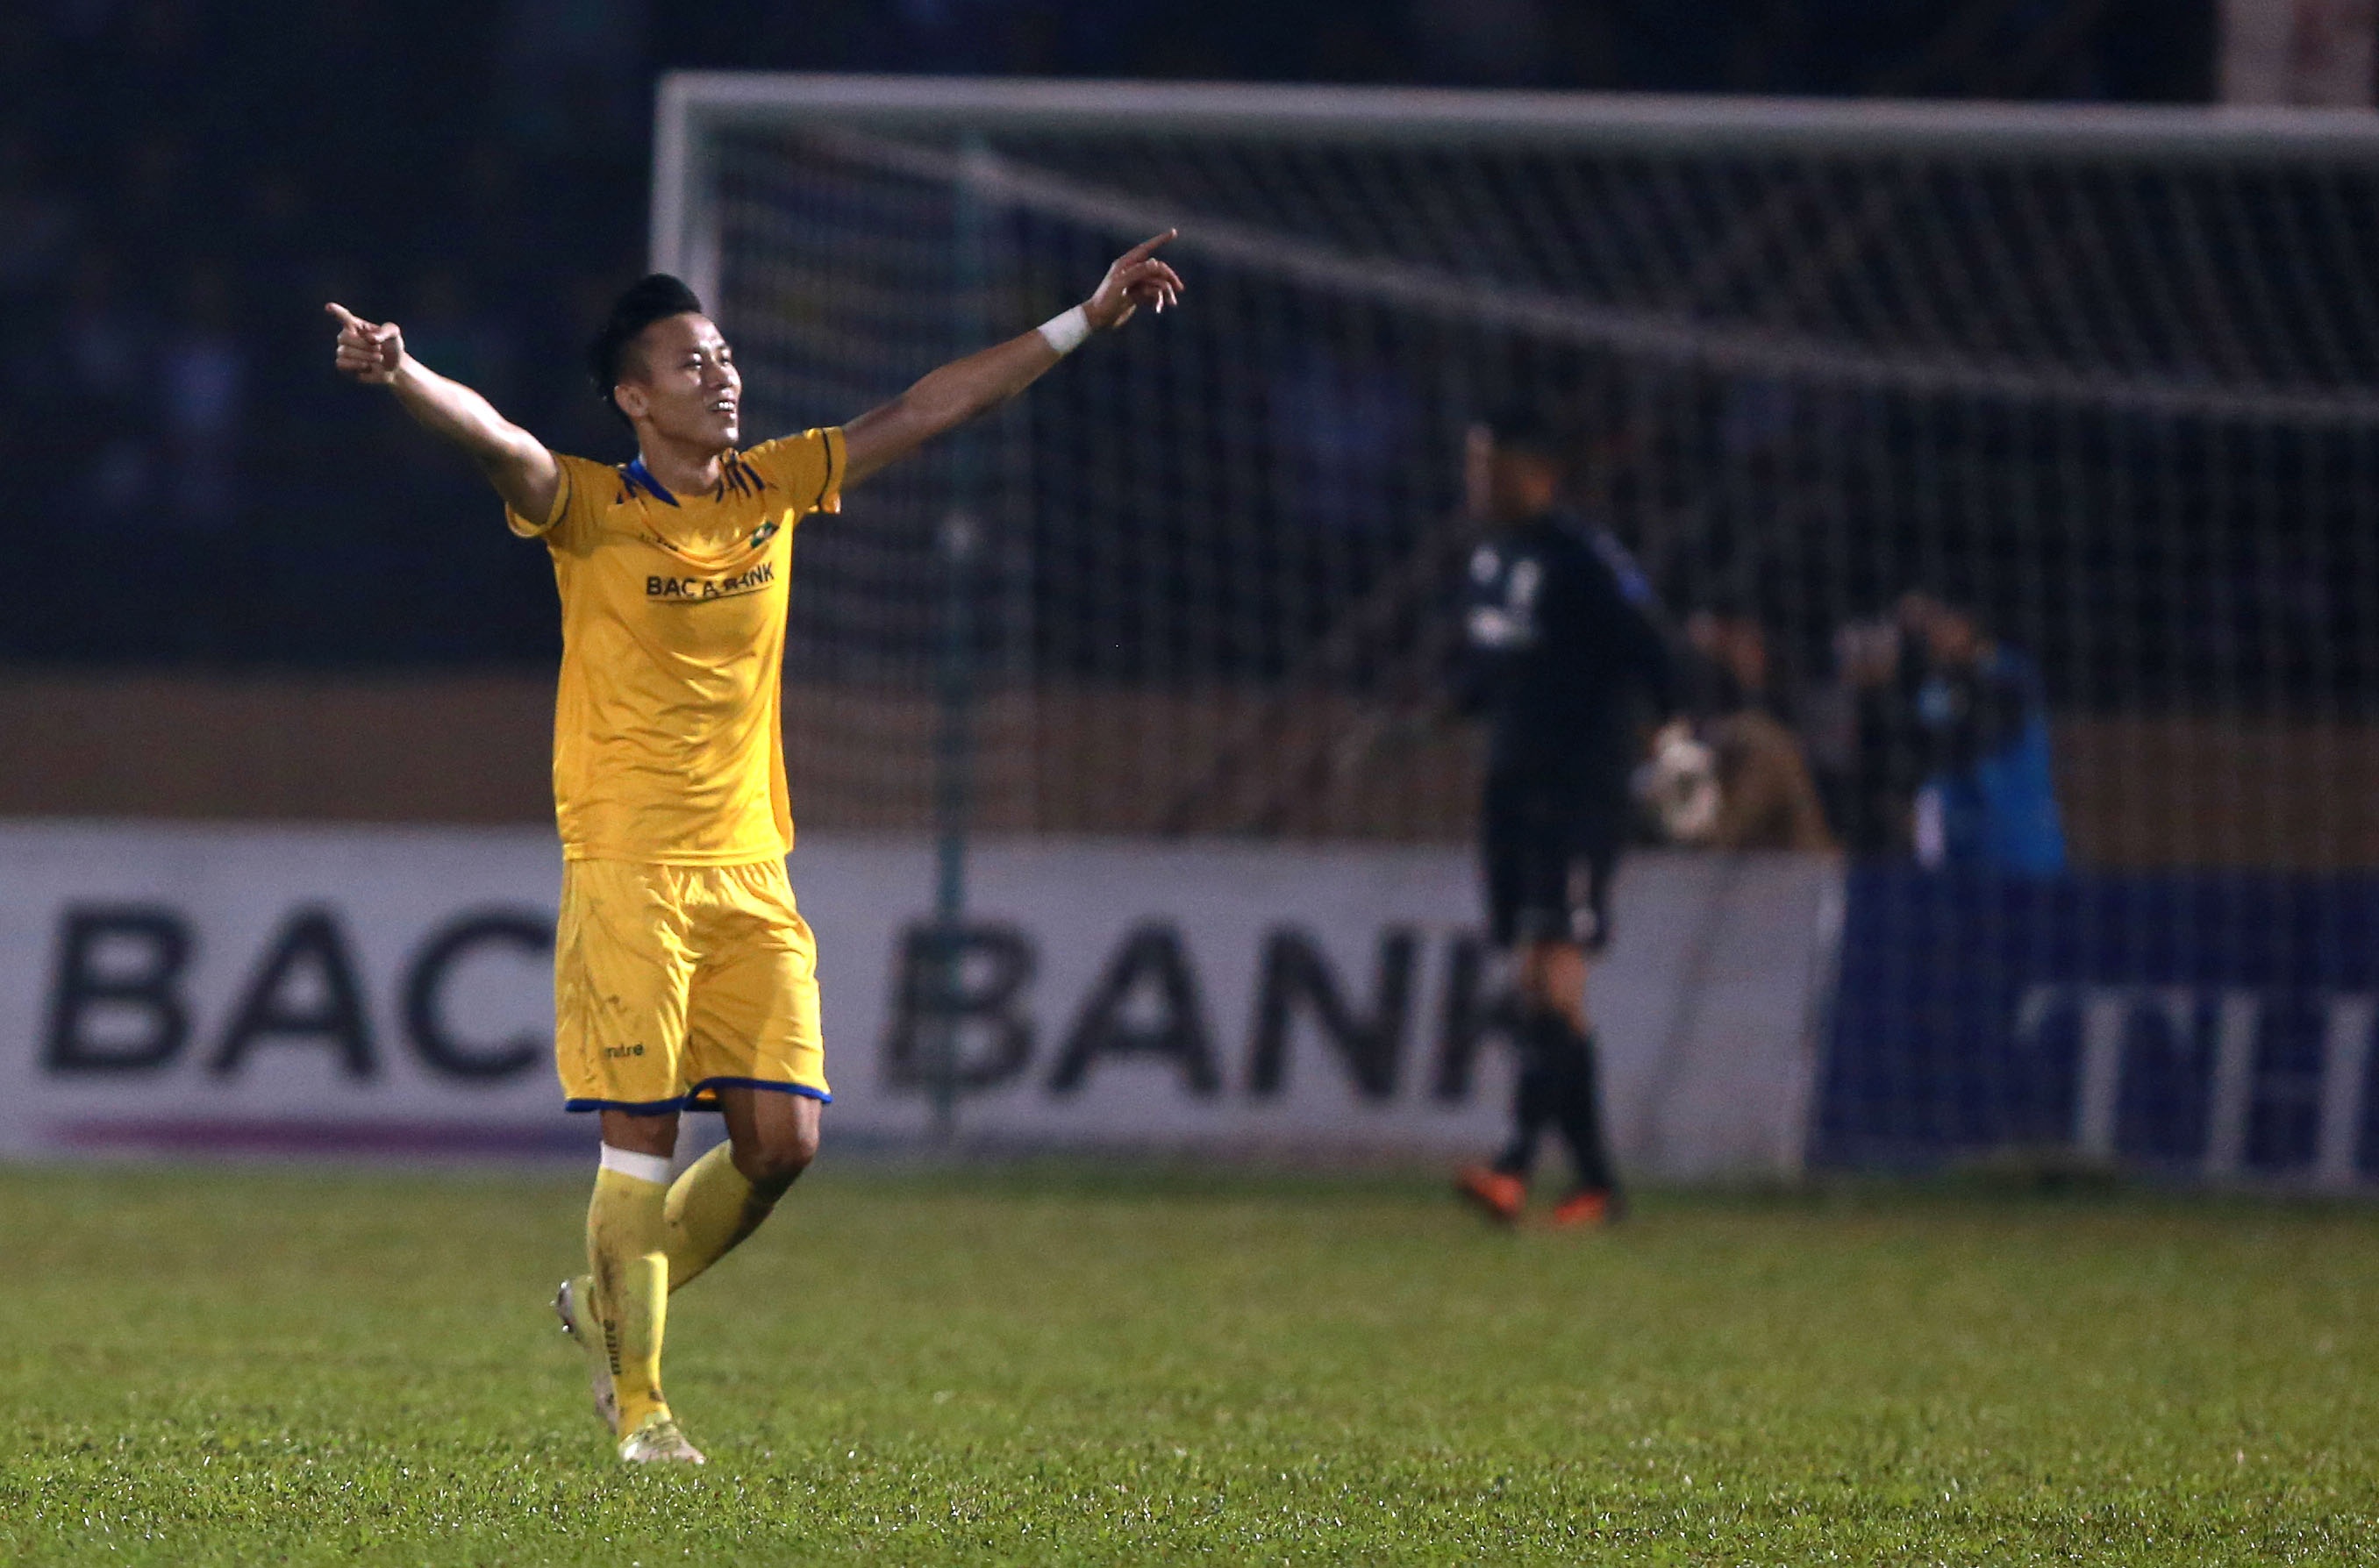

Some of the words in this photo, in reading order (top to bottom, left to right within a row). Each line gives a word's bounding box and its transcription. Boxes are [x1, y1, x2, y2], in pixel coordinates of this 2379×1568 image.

[647, 575, 696, 597] BAC
[703, 581, 719, 597] A
[40, 902, 560, 1080] BAC
